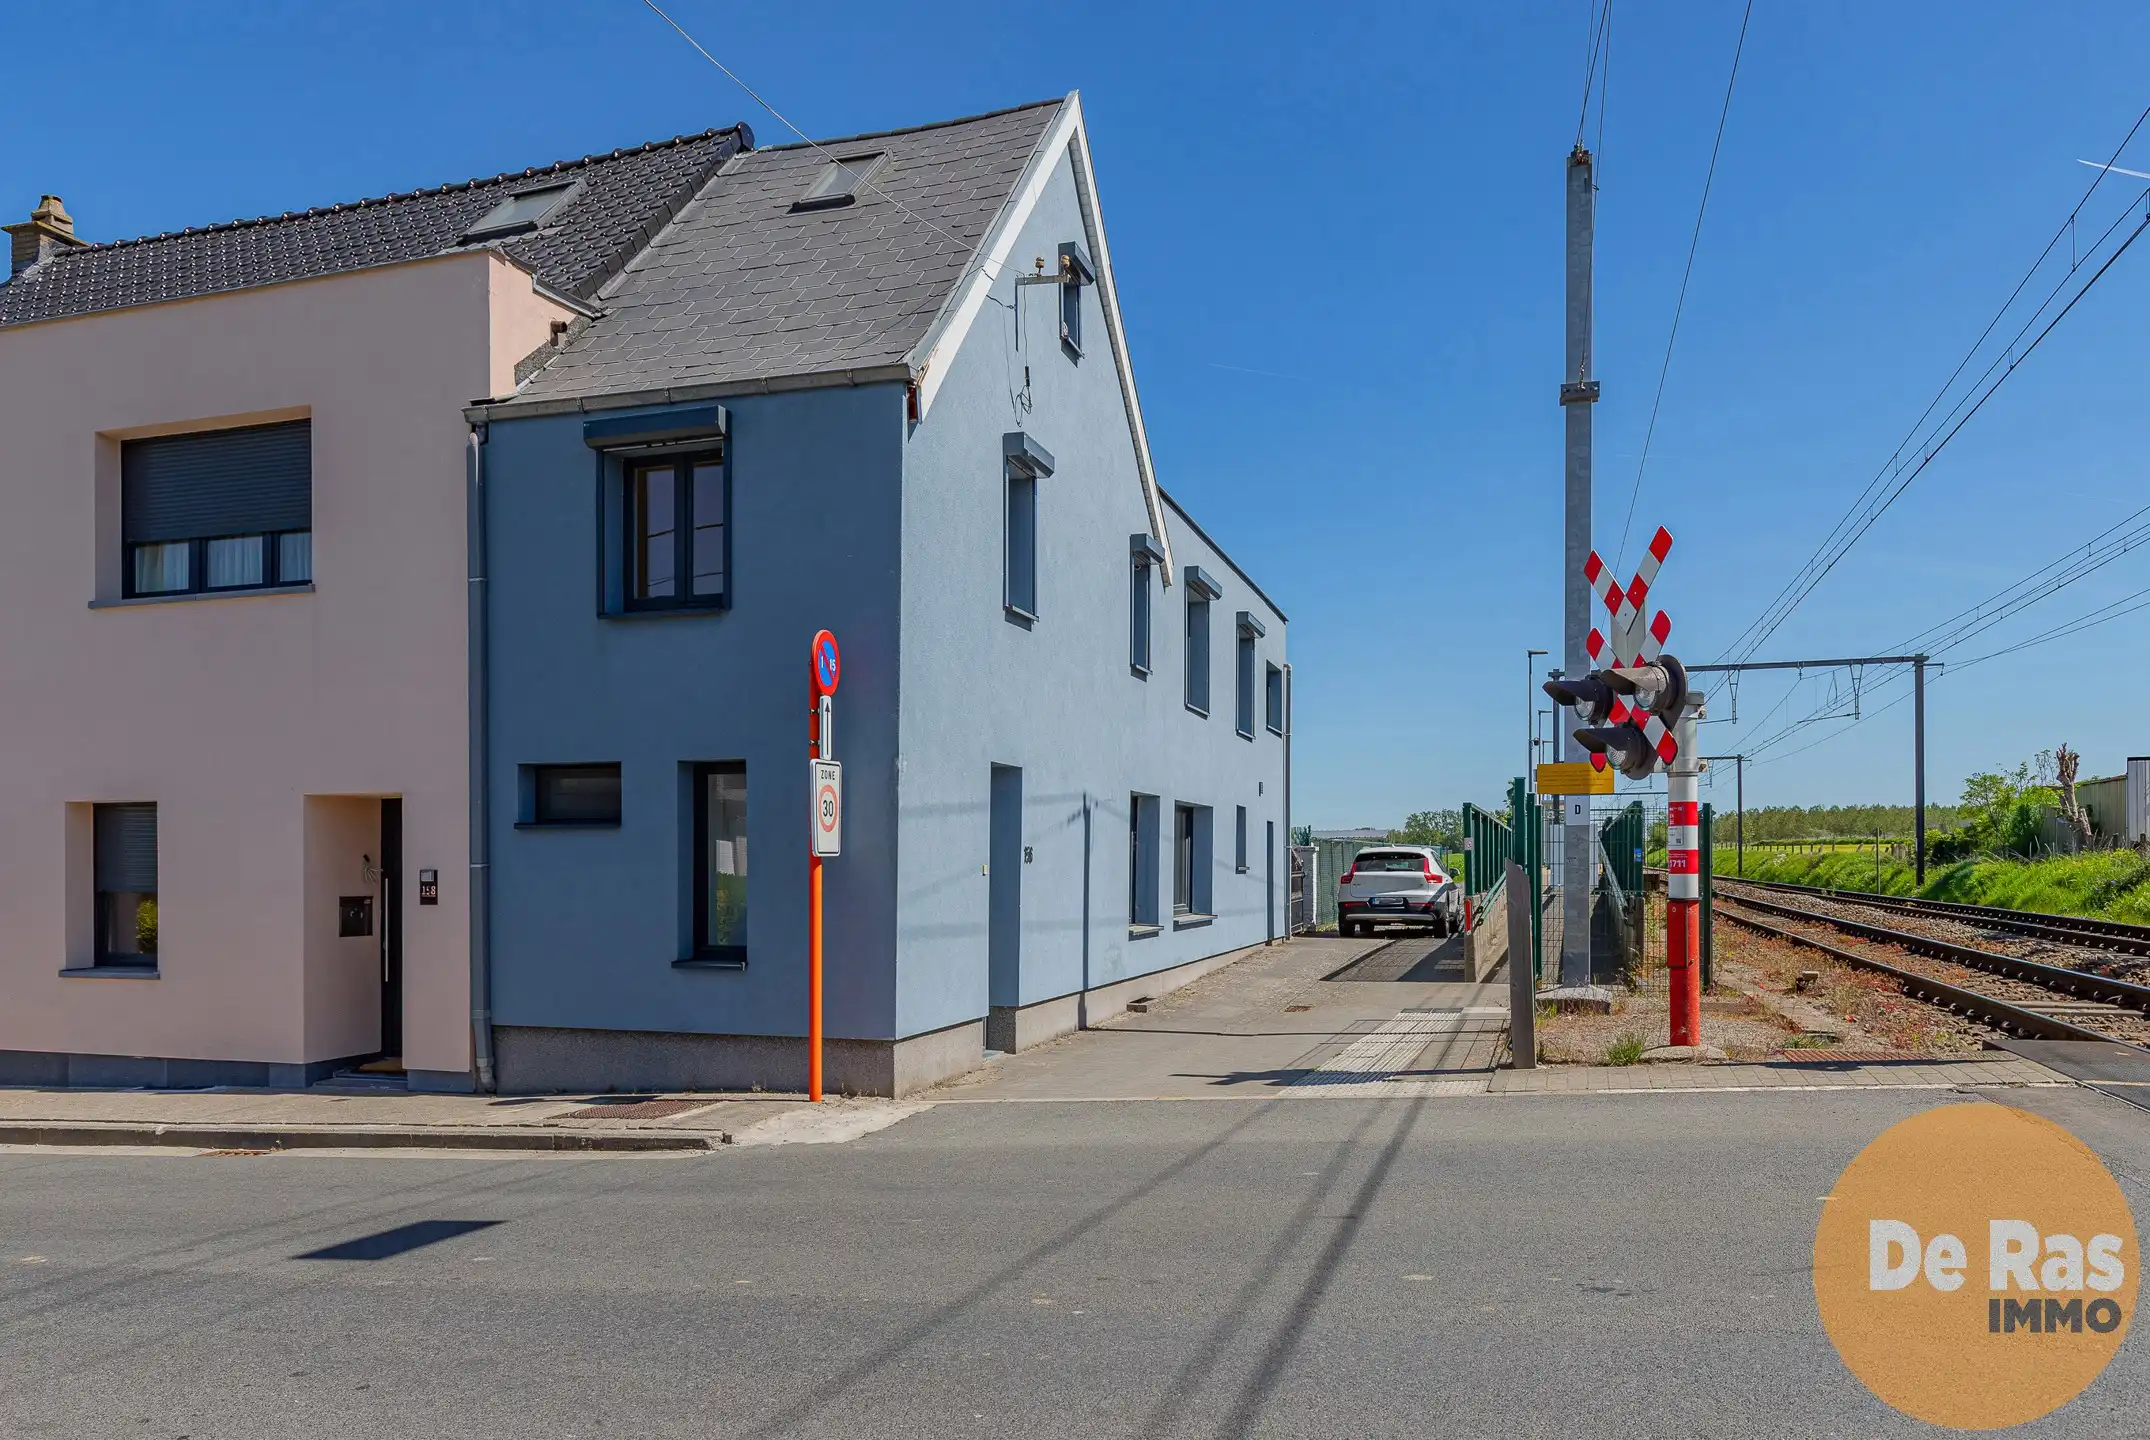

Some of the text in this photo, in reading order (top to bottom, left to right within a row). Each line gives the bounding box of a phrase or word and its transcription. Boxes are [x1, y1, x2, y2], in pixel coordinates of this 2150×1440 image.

[821, 769, 836, 780] ZONE
[822, 799, 834, 817] 30
[1575, 804, 1581, 815] D
